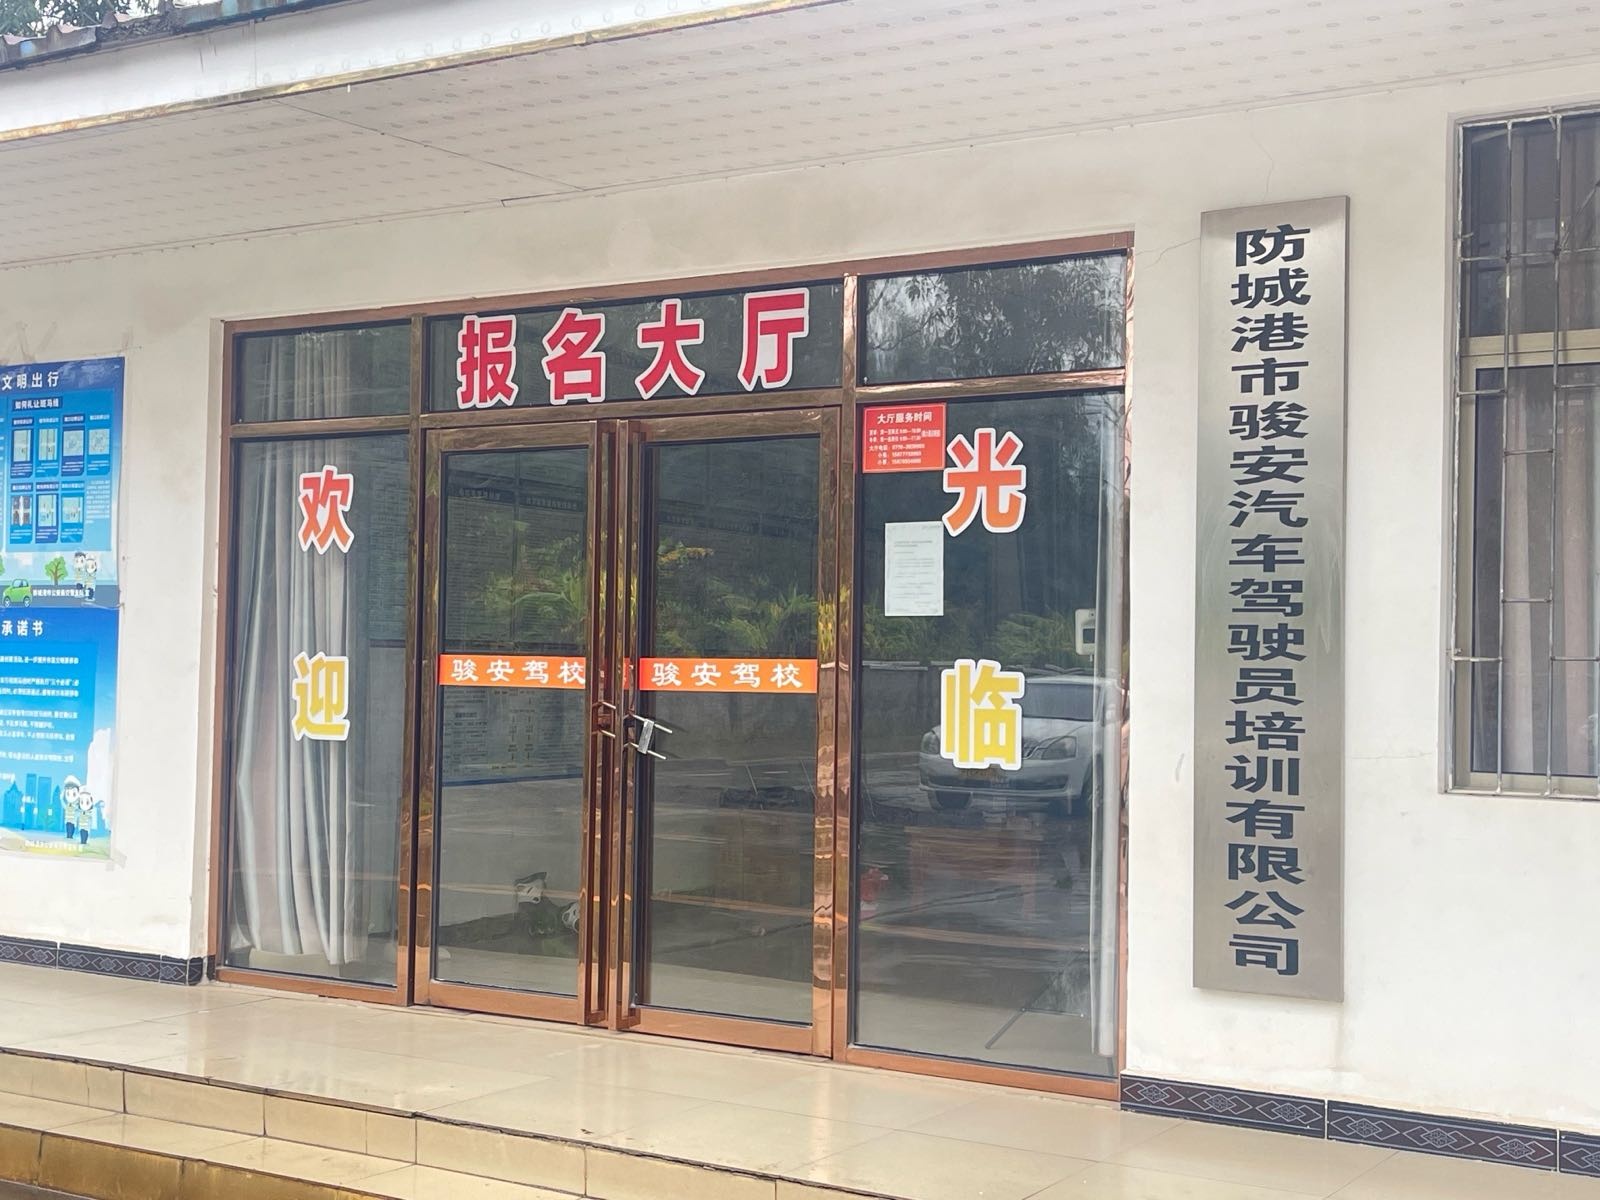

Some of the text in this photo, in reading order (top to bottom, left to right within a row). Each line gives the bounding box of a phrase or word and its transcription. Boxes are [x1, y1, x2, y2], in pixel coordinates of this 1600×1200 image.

[457, 288, 809, 409] 报名大厅
[1, 371, 59, 391] 文明出行
[877, 411, 932, 424] 大厅服务时间
[1224, 223, 1311, 976] 防城港市骏安汽车驾驶员培训有限公司
[2, 620, 43, 637] 承诺书
[451, 659, 585, 683] 骏安驾校
[651, 662, 803, 688] 骏安驾校
